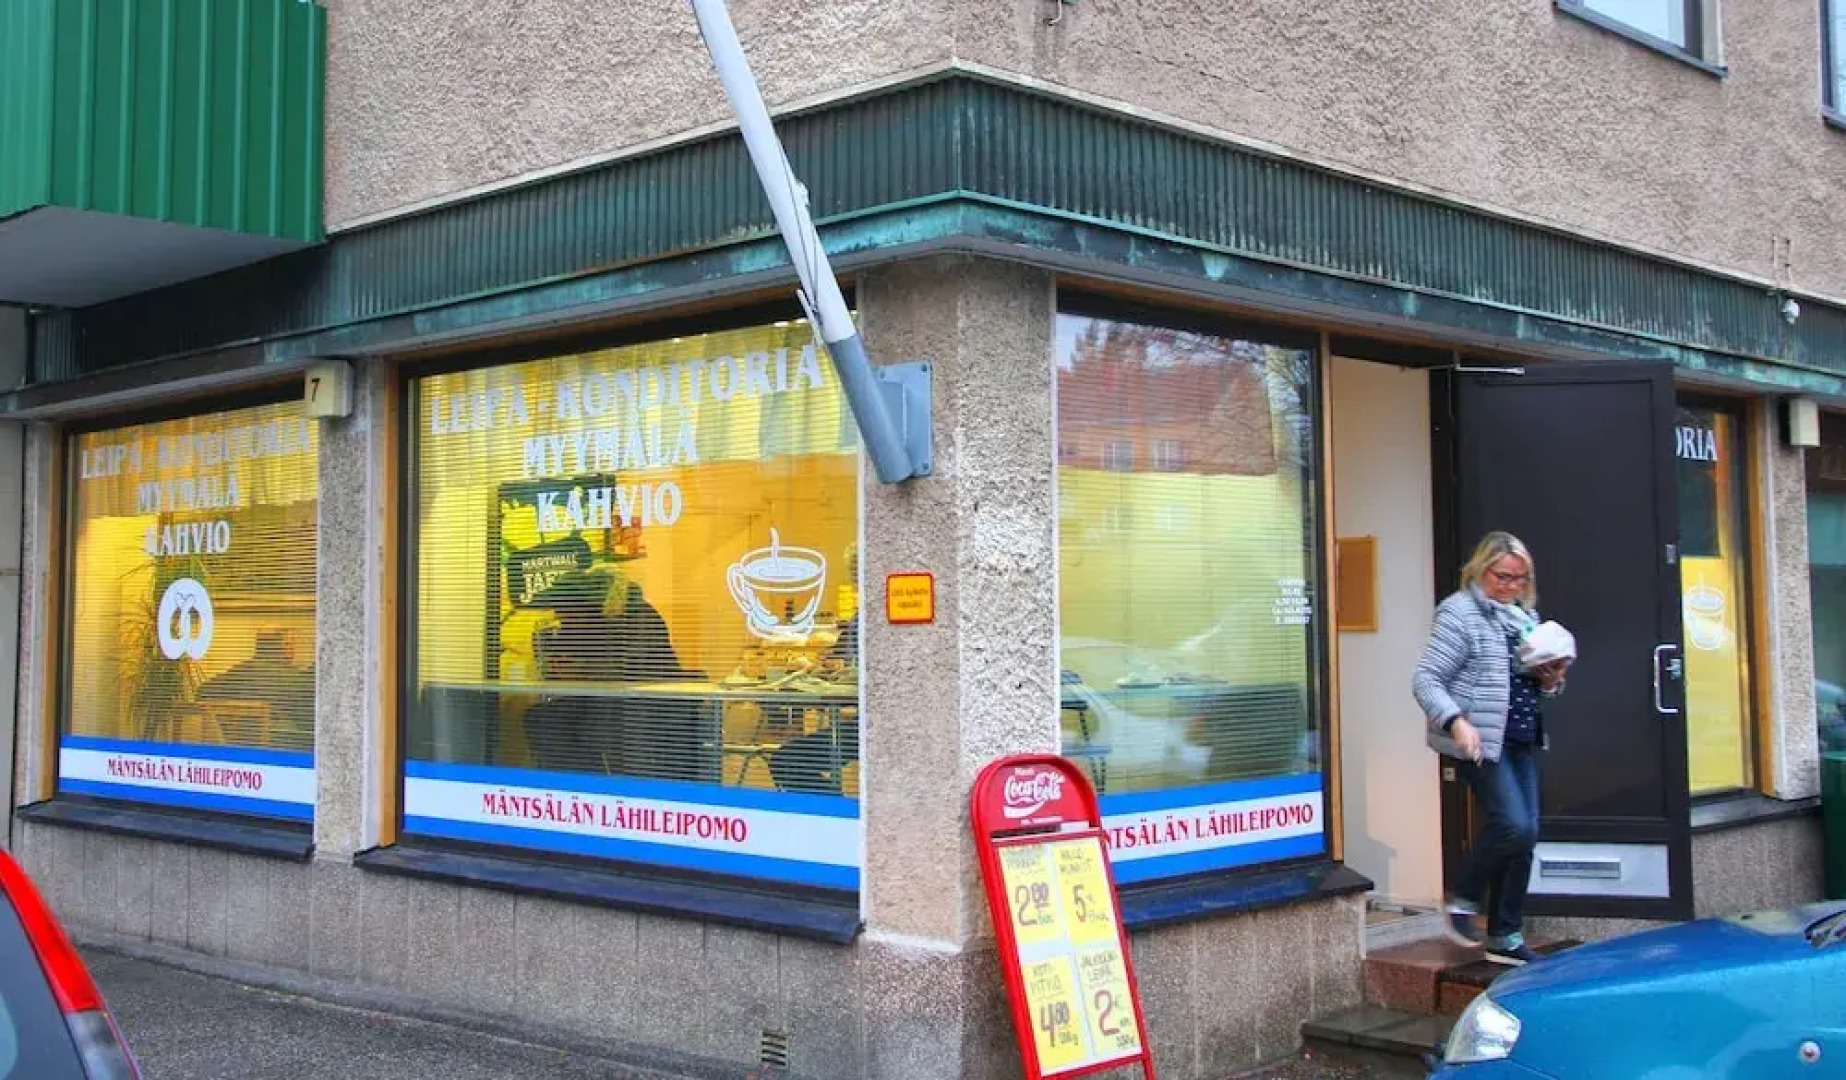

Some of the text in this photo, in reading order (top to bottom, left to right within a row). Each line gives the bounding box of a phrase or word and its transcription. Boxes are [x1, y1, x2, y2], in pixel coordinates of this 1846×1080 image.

[311, 377, 321, 402] 7
[556, 343, 823, 420] KONDITORIA
[522, 407, 700, 478] MYYMÄLÄ
[536, 482, 682, 533] KAHVIO
[144, 519, 231, 557] KAHVIO
[106, 754, 263, 791] MÄNTSÄLÄN LÄHILEIPOMO
[481, 787, 748, 843] MÄNTSÄLÄN LÄHILEIPOMO
[1102, 802, 1314, 850] NTSÄLÄN LÄHILEIPOMO
